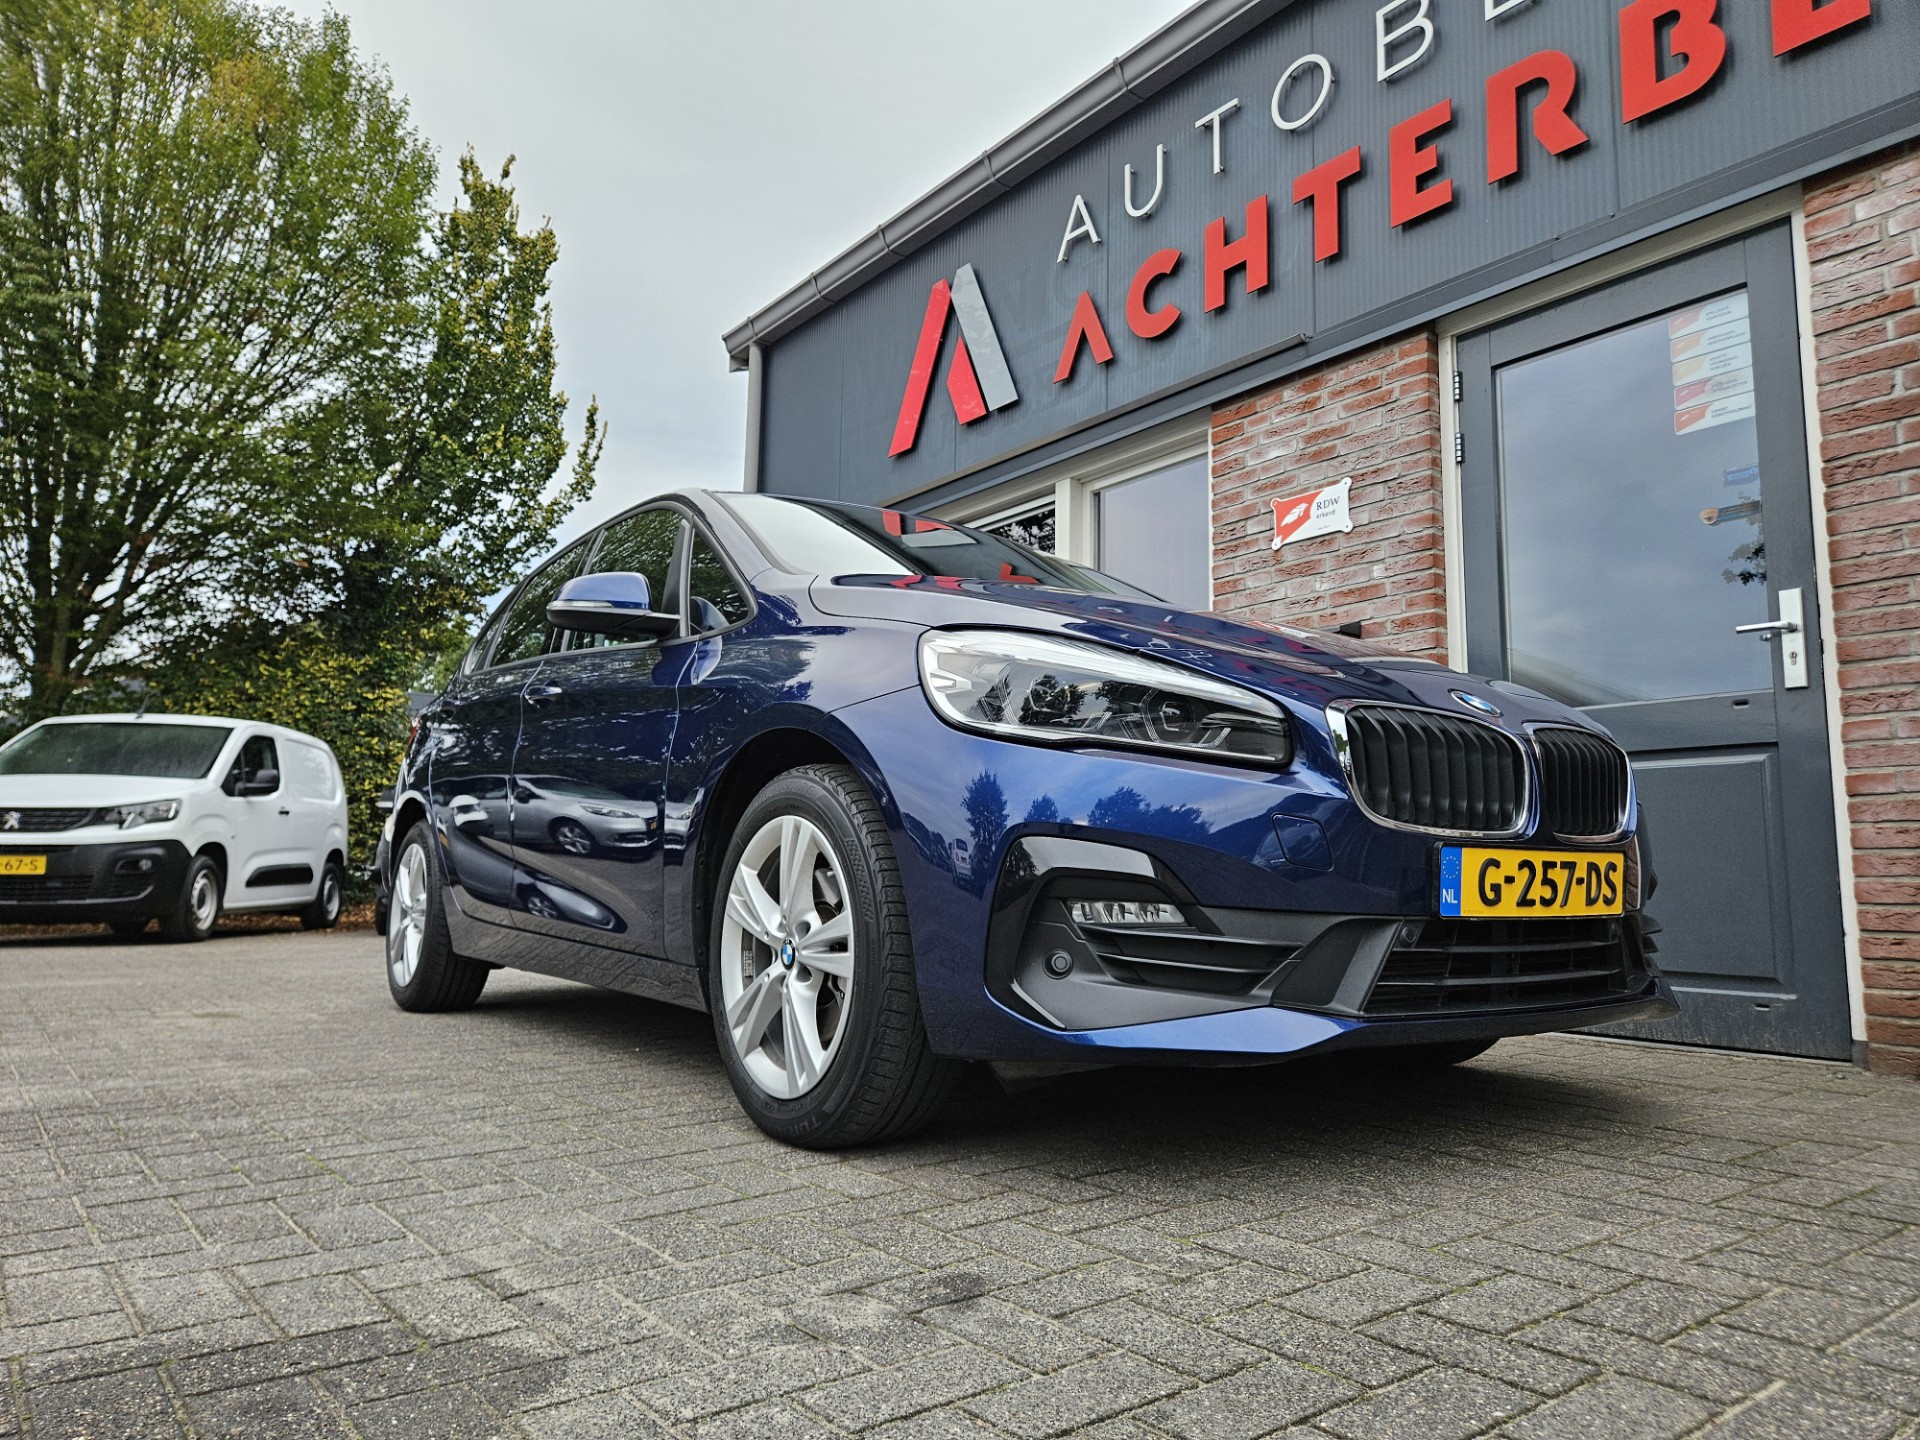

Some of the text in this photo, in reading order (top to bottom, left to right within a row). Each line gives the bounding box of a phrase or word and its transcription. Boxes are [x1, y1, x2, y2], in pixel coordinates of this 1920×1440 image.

[1057, 0, 1536, 263] AUTOB
[1316, 495, 1341, 511] RDW
[1442, 888, 1458, 904] NL
[1478, 857, 1618, 908] G-257-DS
